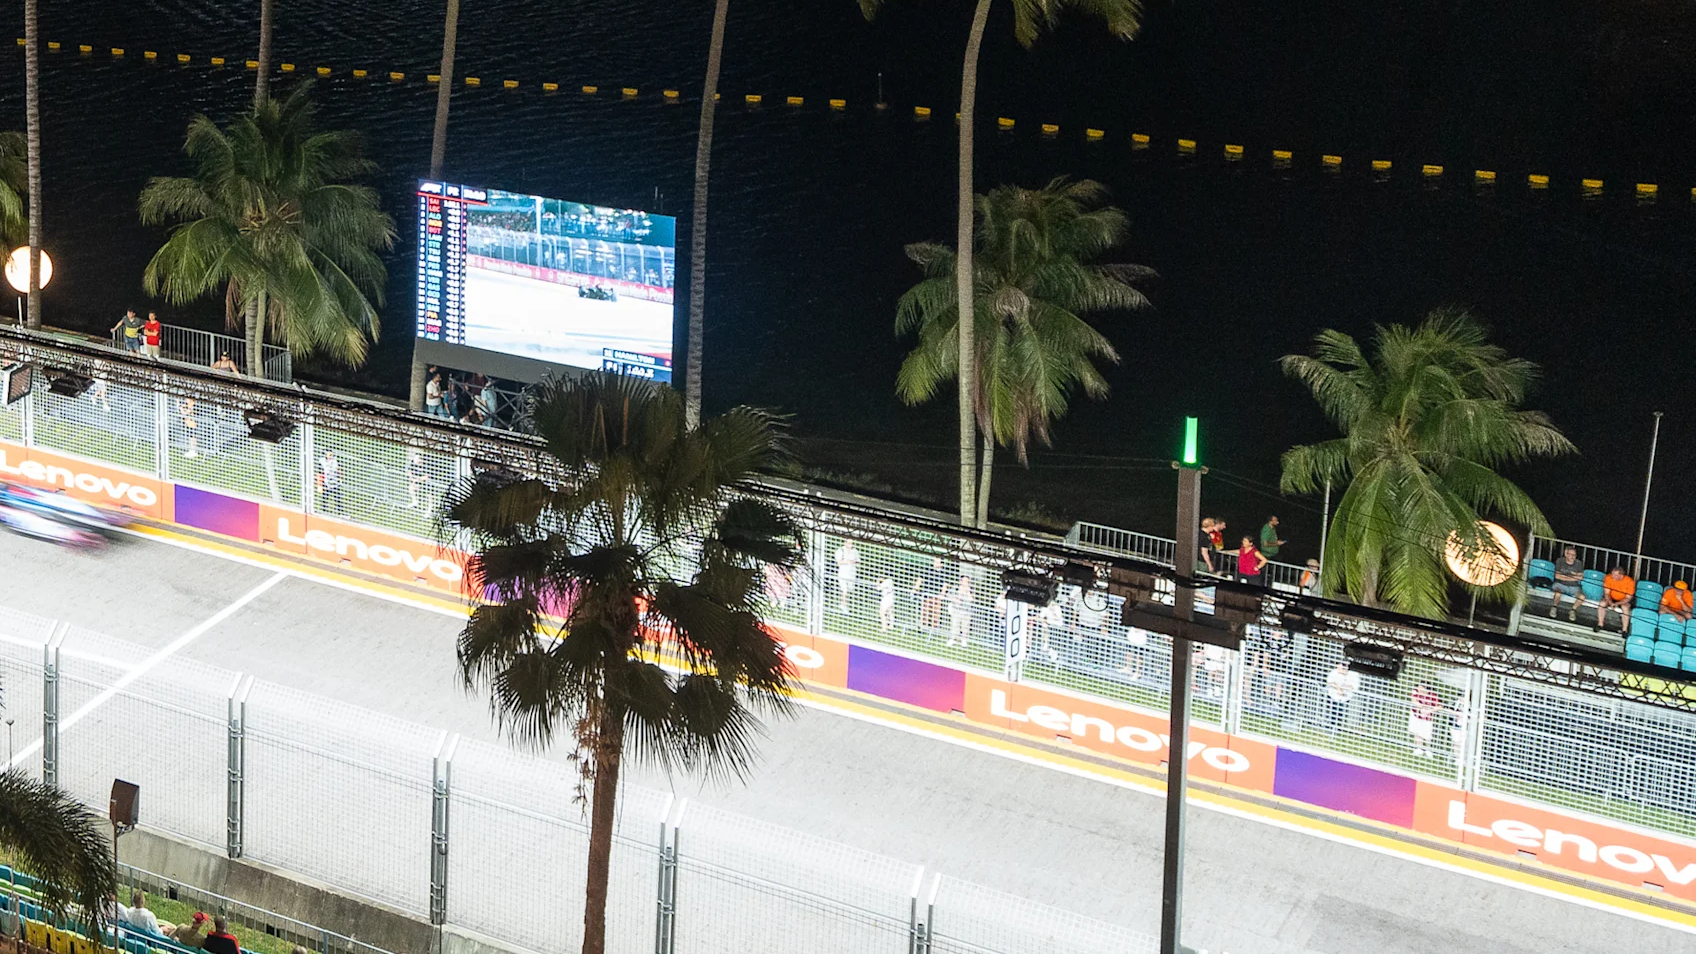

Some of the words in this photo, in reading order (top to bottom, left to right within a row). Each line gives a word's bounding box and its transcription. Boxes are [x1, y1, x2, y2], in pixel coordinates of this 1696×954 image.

[277, 517, 463, 582] Lenovo
[991, 689, 1250, 773] Lenovo
[1448, 799, 1696, 885] Lenov
